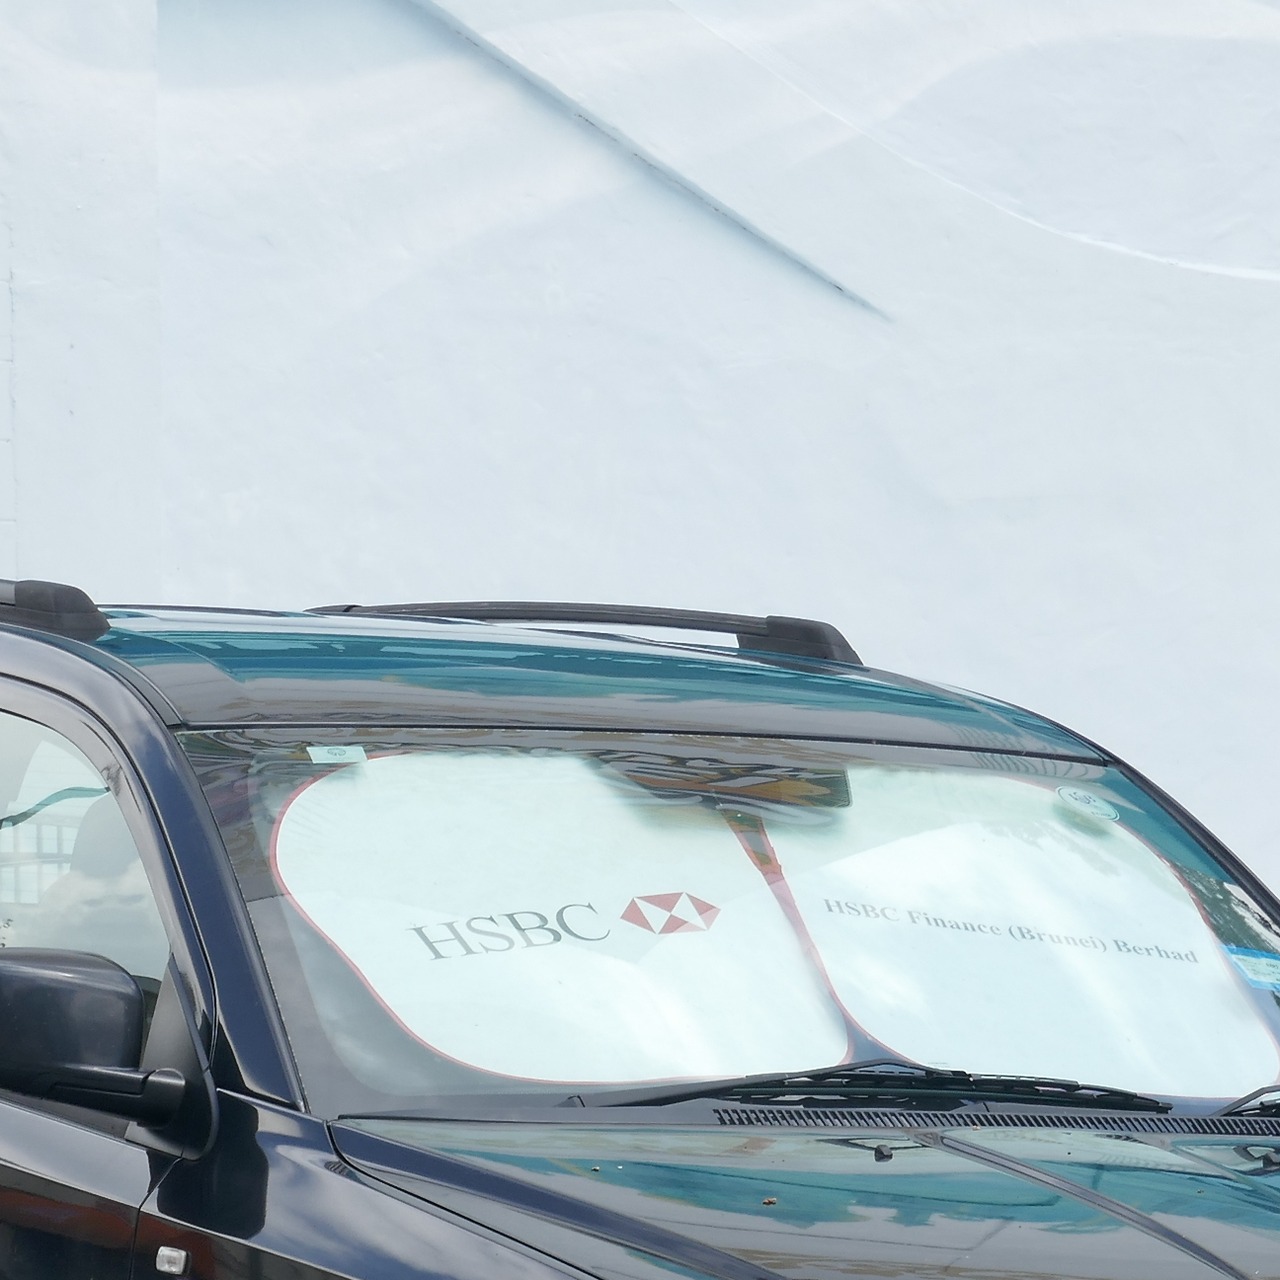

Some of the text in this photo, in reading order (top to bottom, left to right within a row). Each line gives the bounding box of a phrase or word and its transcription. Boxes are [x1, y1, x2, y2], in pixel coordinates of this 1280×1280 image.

[404, 902, 611, 961] HSBC
[824, 899, 1200, 964] HSBC Finance (Brunei) Berhad
